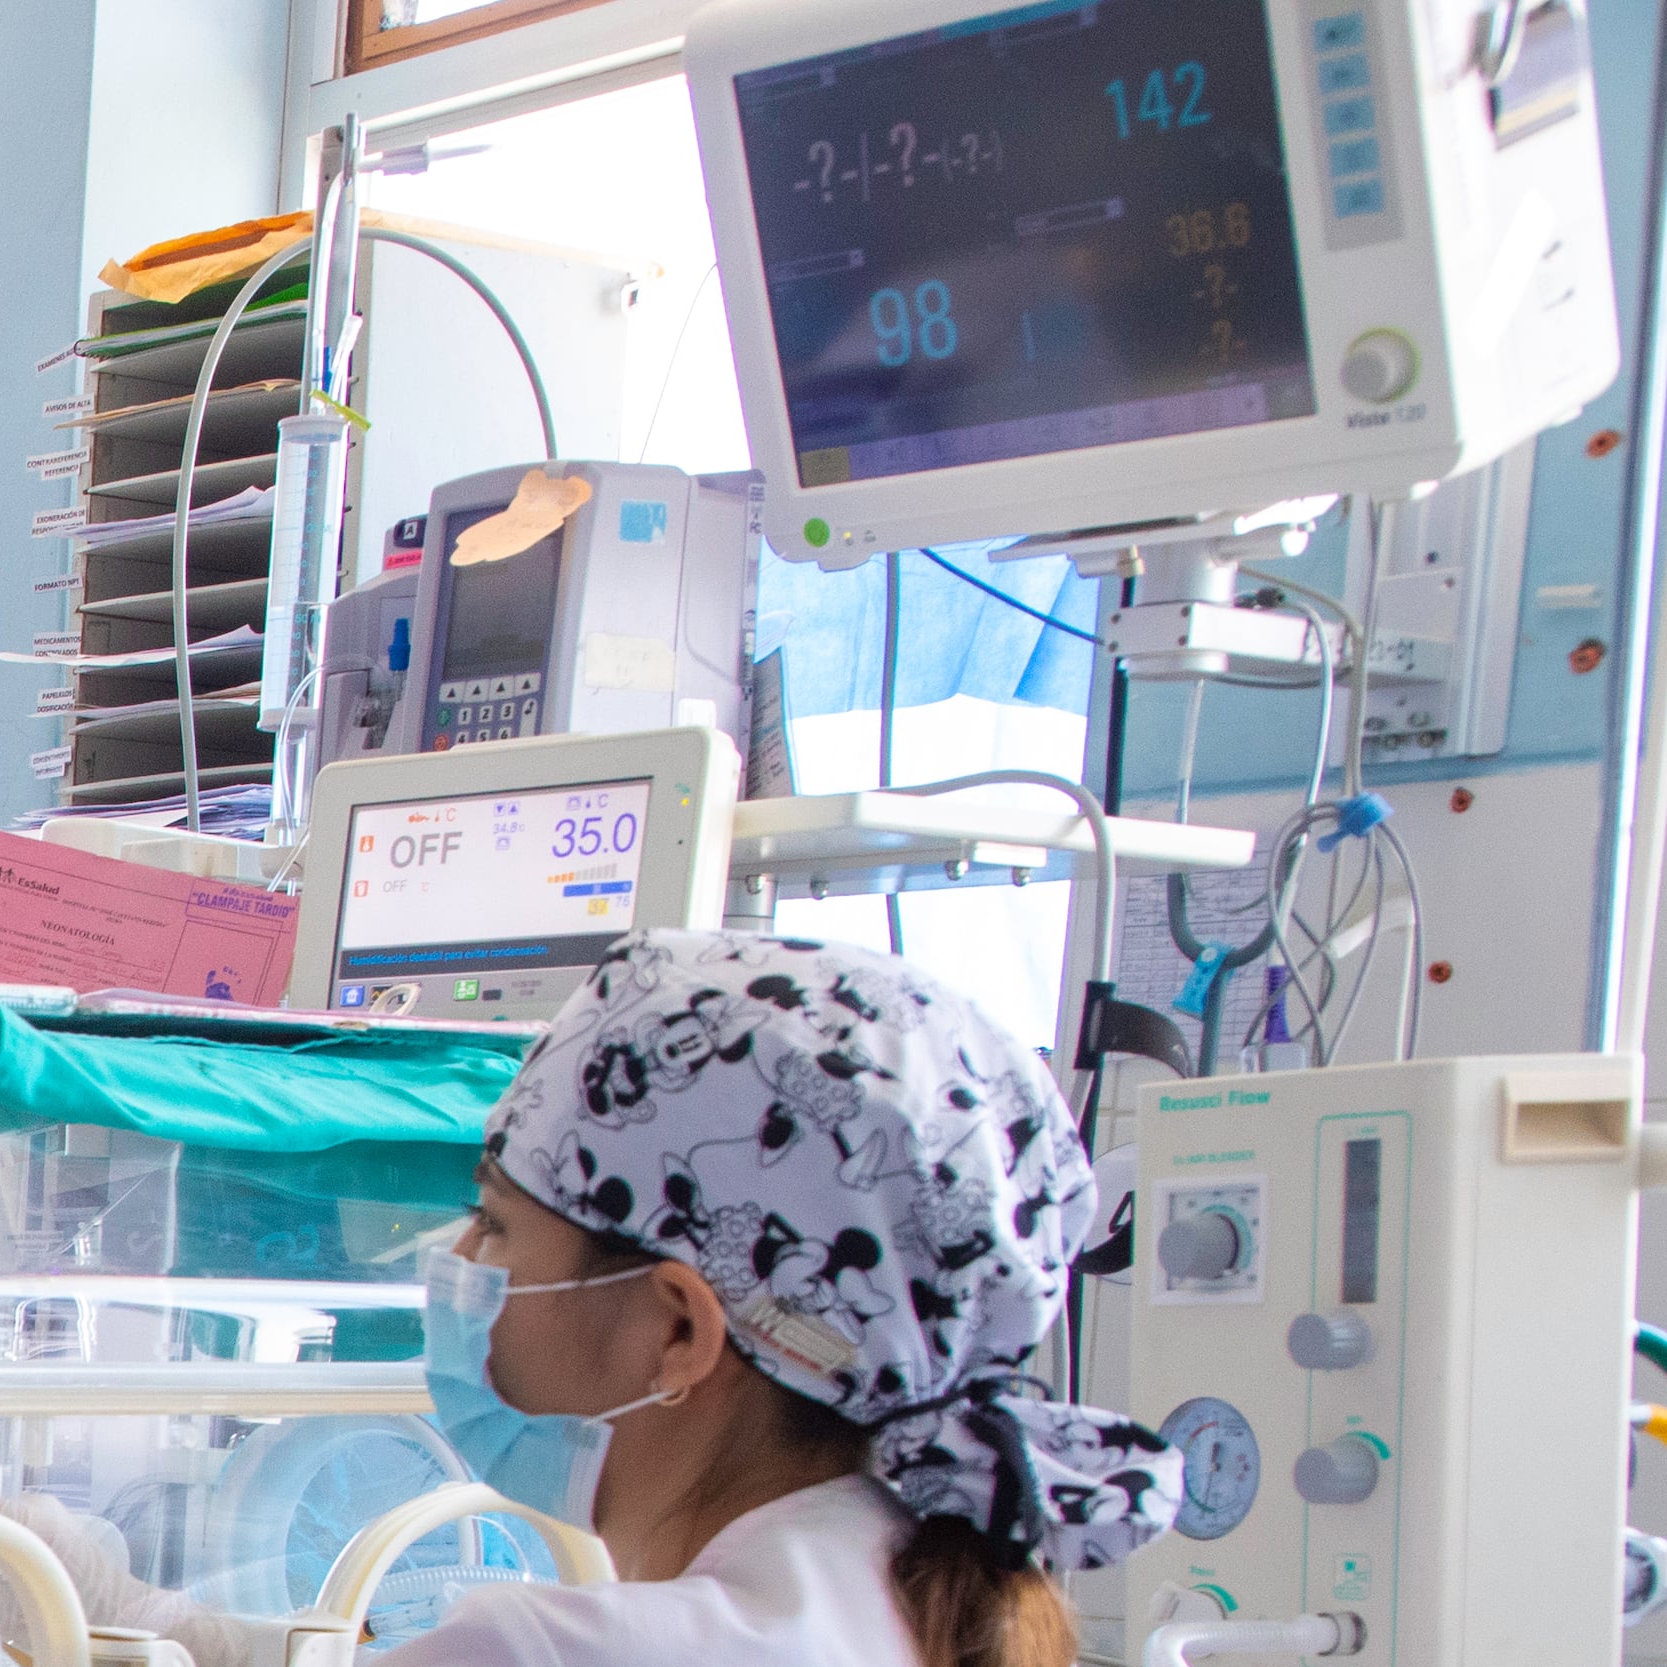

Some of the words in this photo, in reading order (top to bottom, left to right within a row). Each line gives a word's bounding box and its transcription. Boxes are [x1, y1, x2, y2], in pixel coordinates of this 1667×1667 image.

[1105, 61, 1212, 138] 142
[870, 279, 958, 366] 98
[45, 403, 67, 413] AVISOS
[68, 402, 76, 410] DE
[77, 400, 91, 408] ALTA
[406, 527, 413, 535] A
[35, 580, 66, 591] FORMATO
[34, 636, 81, 645] MEDICAMENTOS
[462, 710, 468, 721] 1
[482, 709, 489, 718] 2
[503, 706, 511, 716] 3
[501, 730, 508, 739] 6
[551, 813, 637, 858] 35.0
[390, 832, 462, 868] OFF
[18, 877, 60, 895] EsSalud
[383, 880, 408, 893] OFF
[41, 920, 116, 946] NEONATOLOGÍA
[1228, 1090, 1271, 1105] Flow
